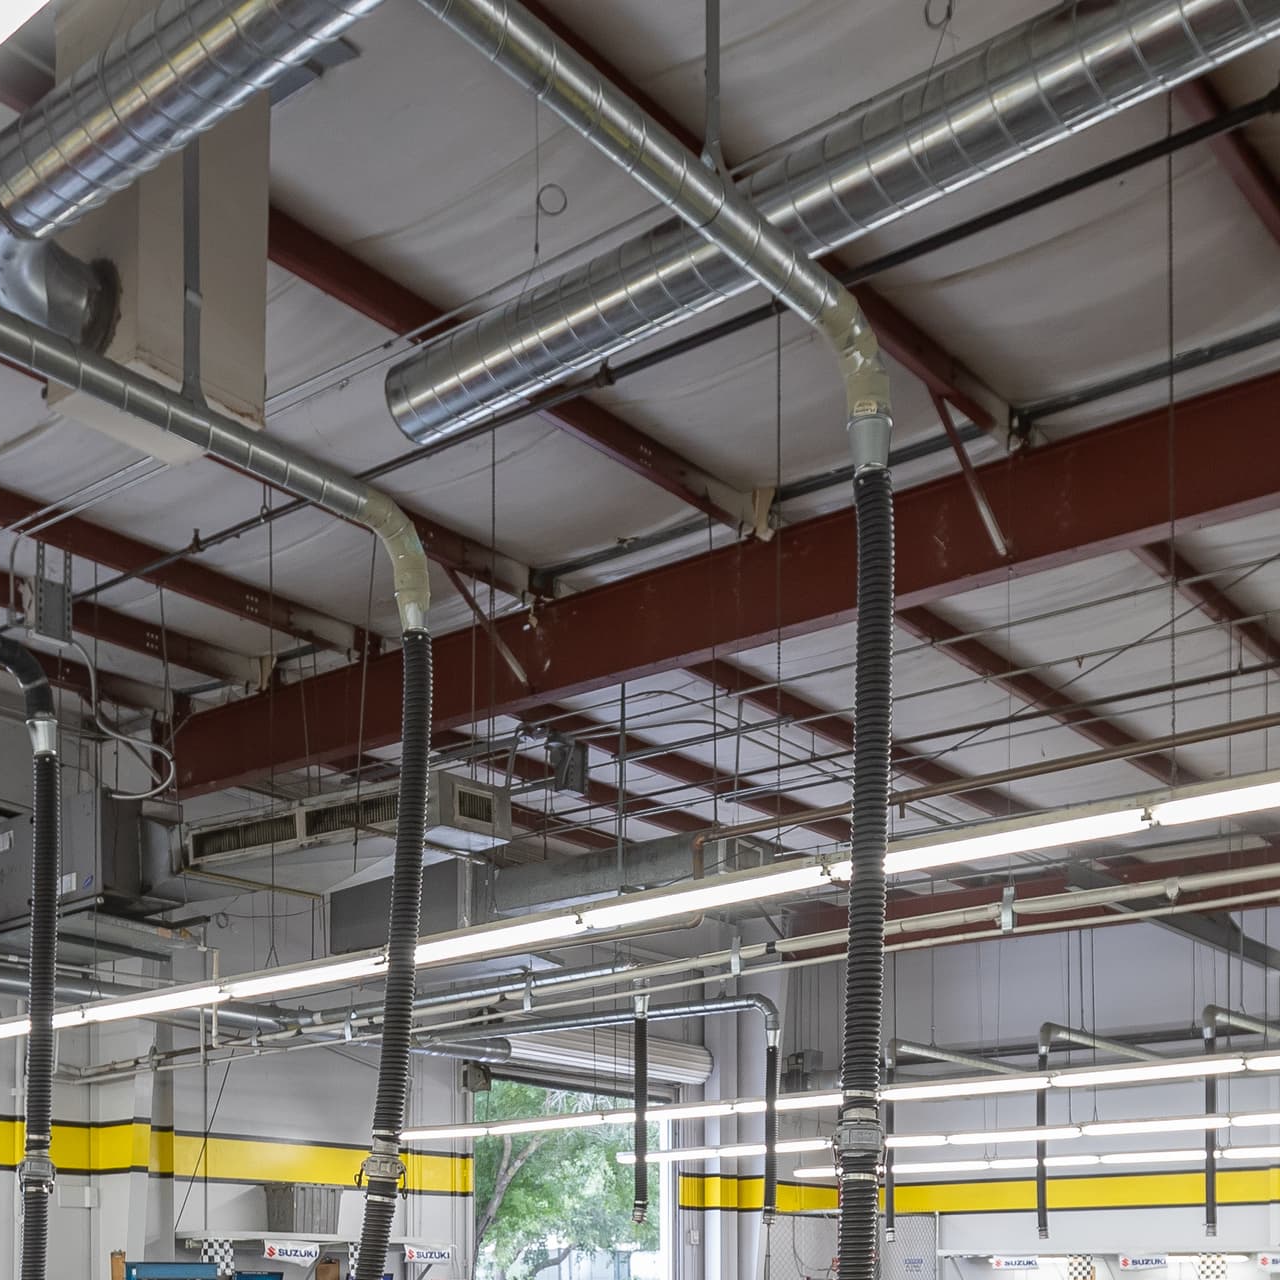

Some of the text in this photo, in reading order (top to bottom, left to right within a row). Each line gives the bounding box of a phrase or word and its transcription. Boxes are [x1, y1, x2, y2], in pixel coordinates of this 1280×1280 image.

[278, 1248, 318, 1258] SUZUKI
[416, 1251, 450, 1259] SUZUKI
[1131, 1258, 1167, 1266] SUZUKI
